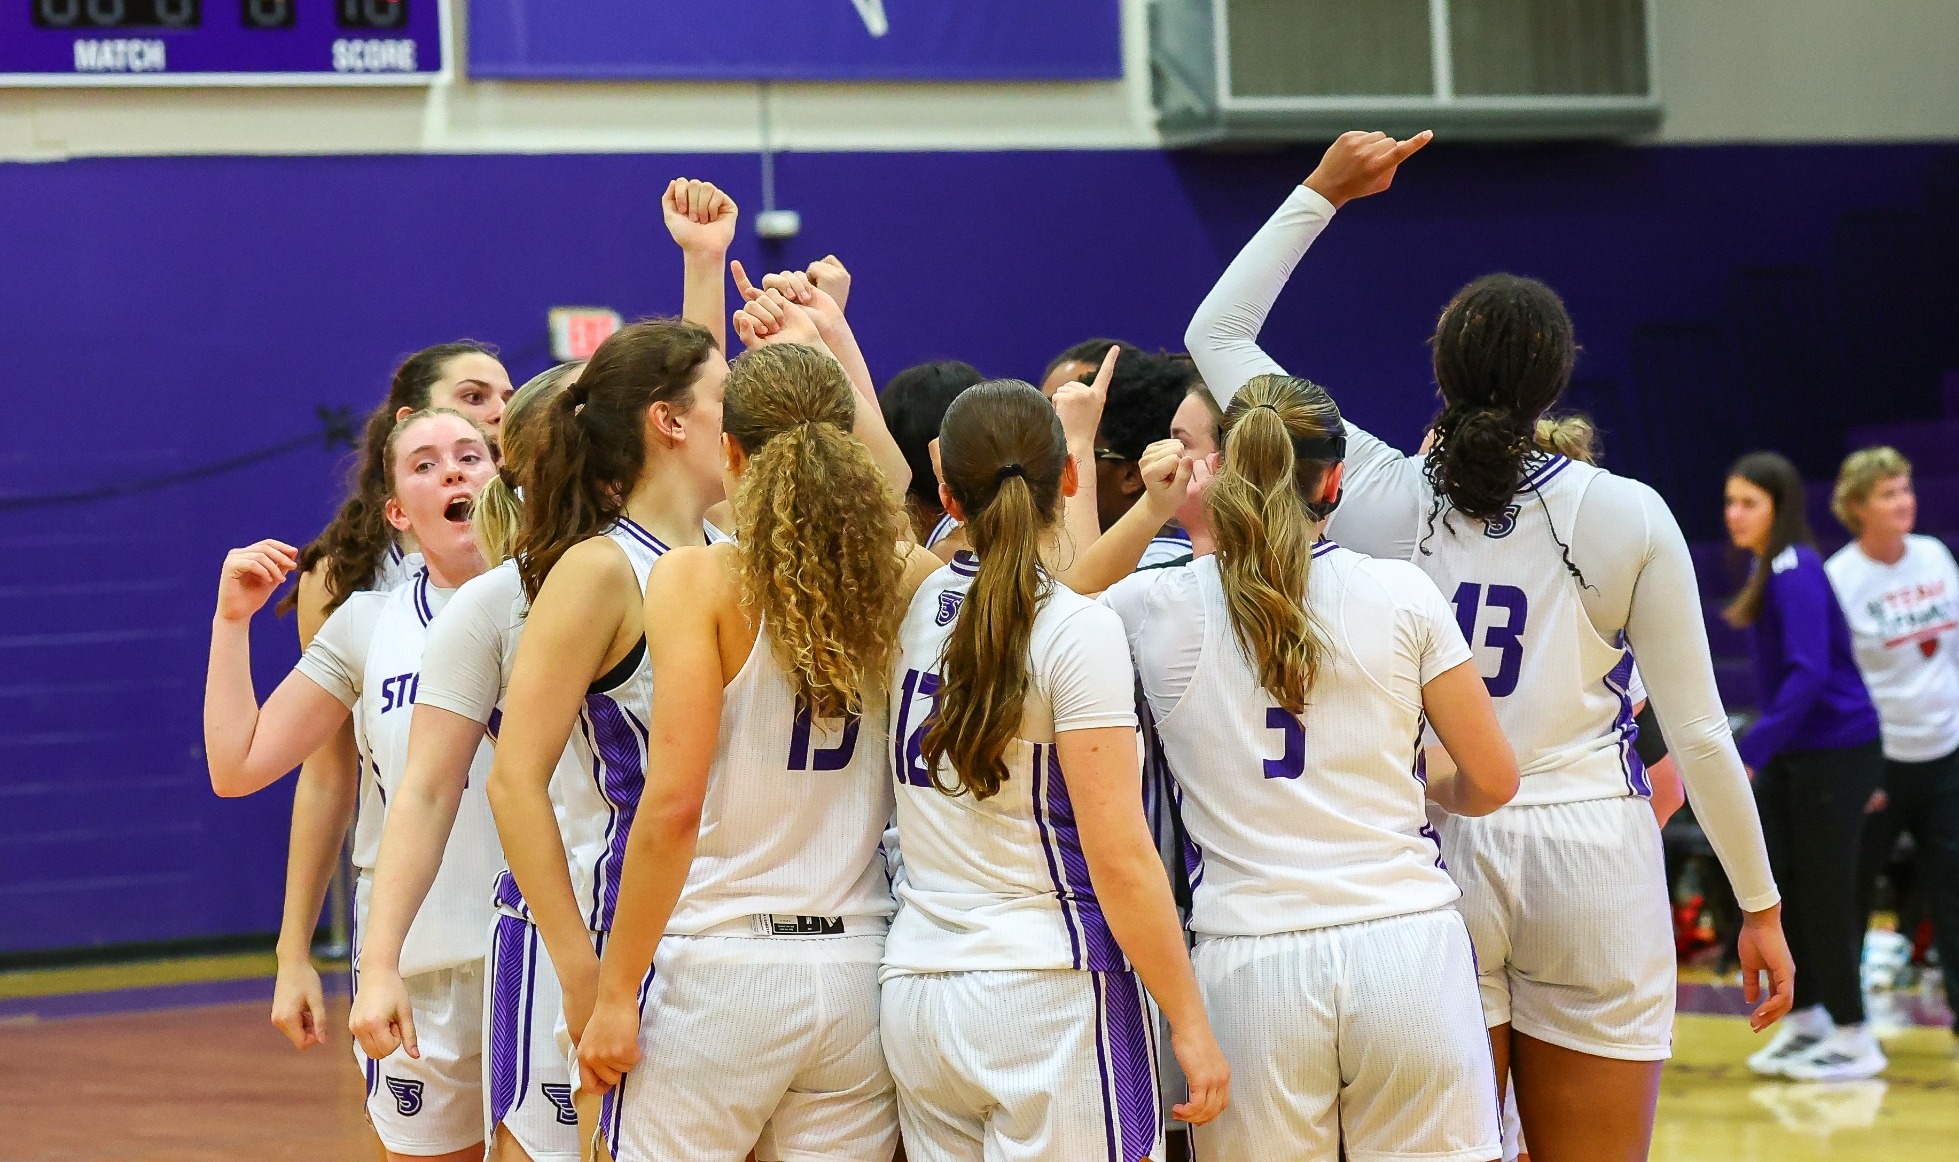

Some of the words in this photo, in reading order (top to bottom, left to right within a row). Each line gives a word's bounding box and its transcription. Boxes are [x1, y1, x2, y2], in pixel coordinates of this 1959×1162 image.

[74, 39, 166, 72] MATCH
[332, 39, 417, 72] SCORE
[1451, 581, 1528, 698] 13
